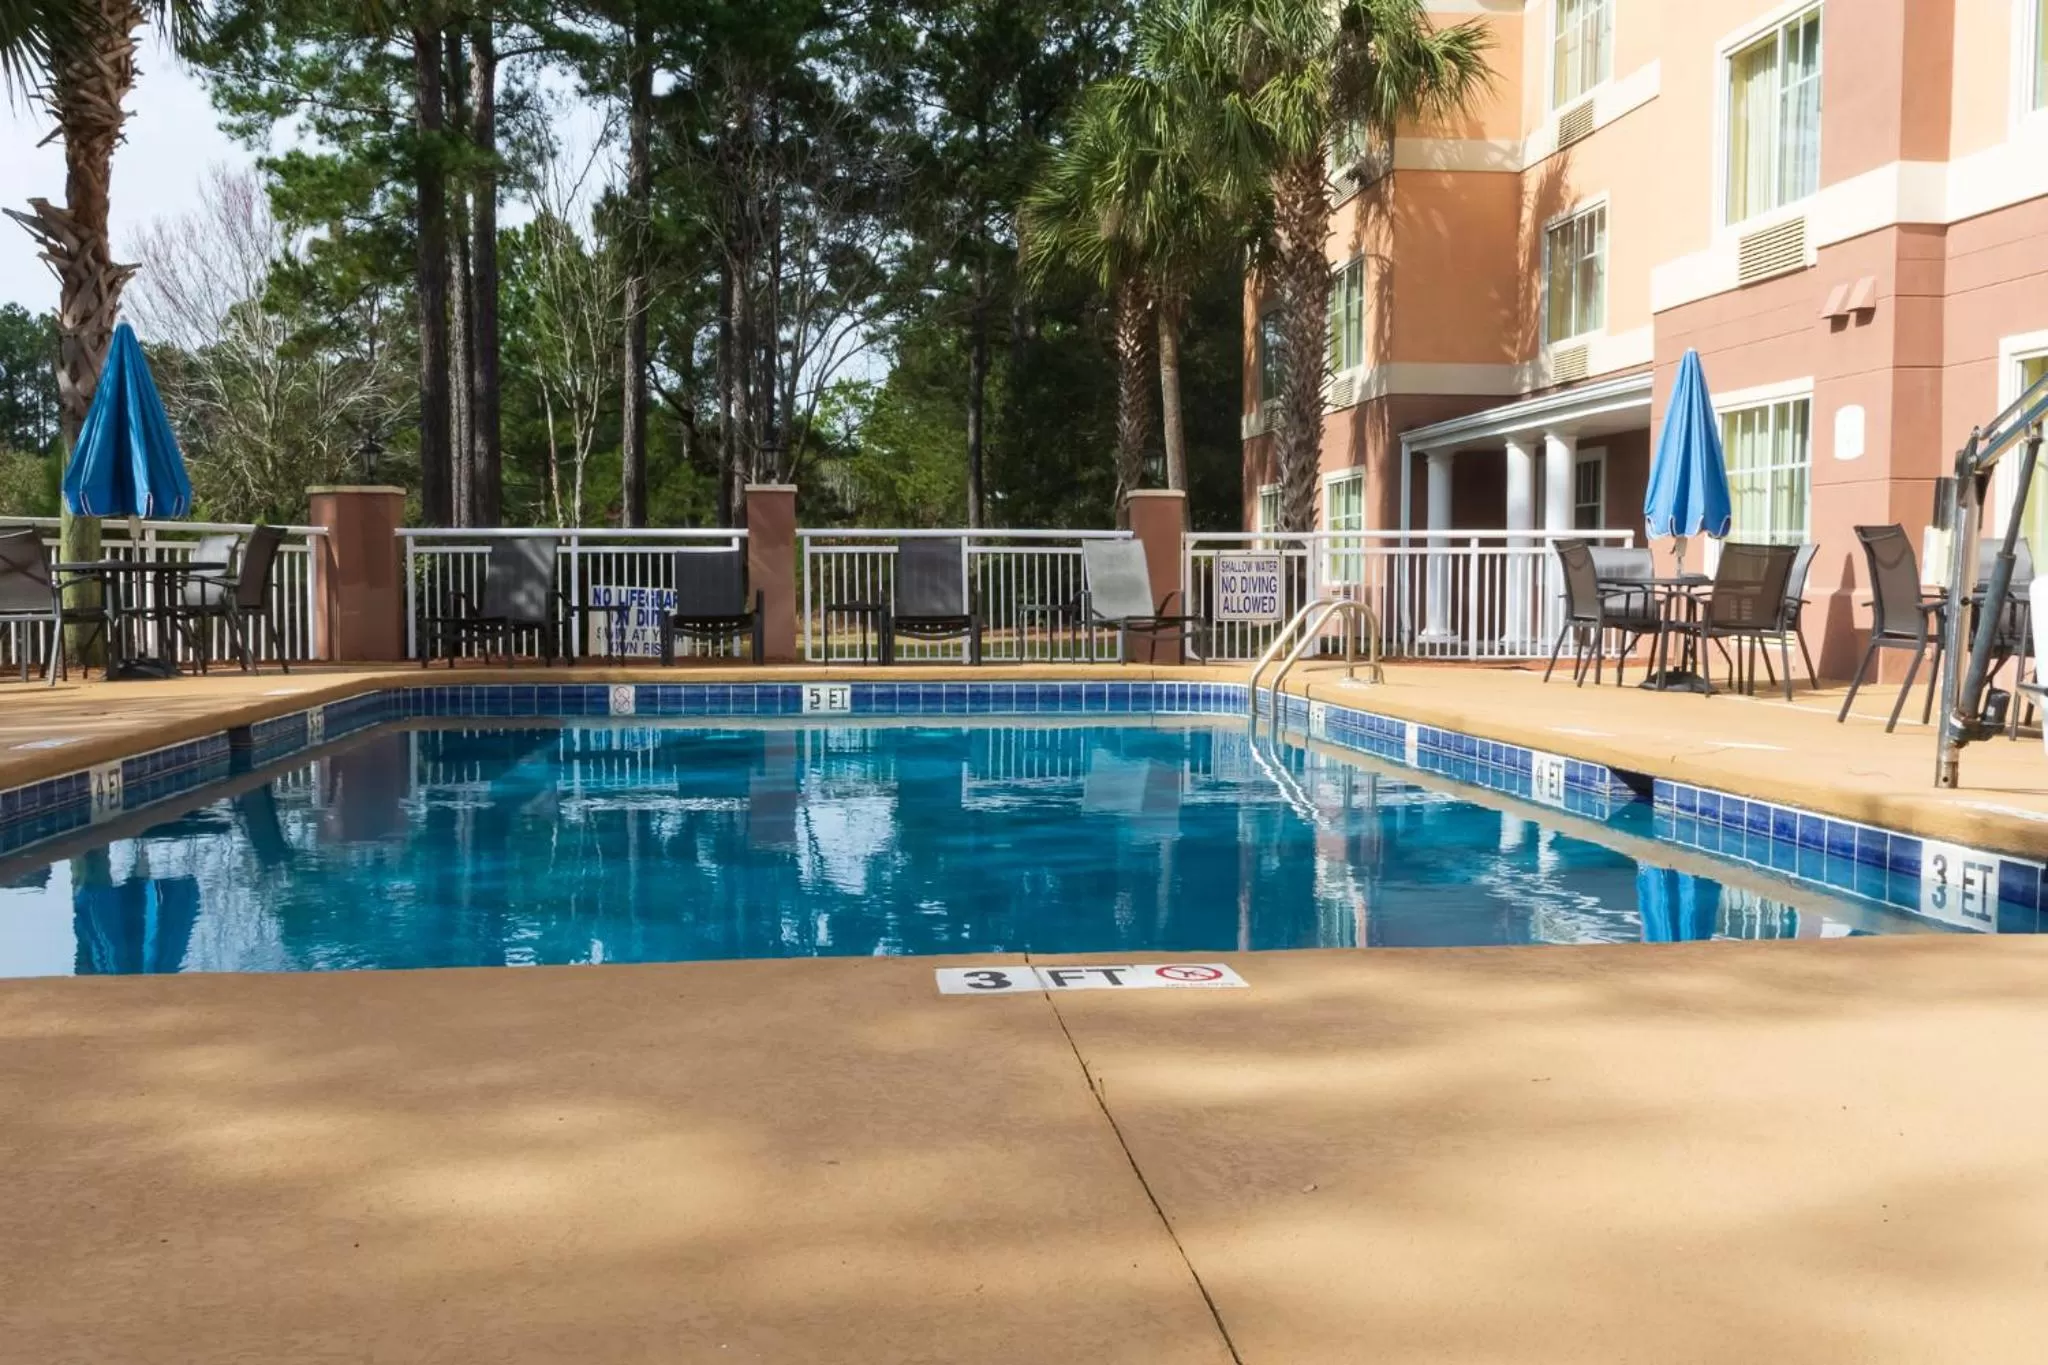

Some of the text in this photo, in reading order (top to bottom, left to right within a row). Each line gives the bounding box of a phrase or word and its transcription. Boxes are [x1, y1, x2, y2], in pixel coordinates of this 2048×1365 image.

[1221, 561, 1278, 573] SHALLOW WATER
[1221, 576, 1278, 594] NO DIVING
[592, 587, 679, 608] NO LIFEGUAR
[1222, 596, 1277, 614] ALLOWED
[963, 968, 1126, 989] 3 FT
